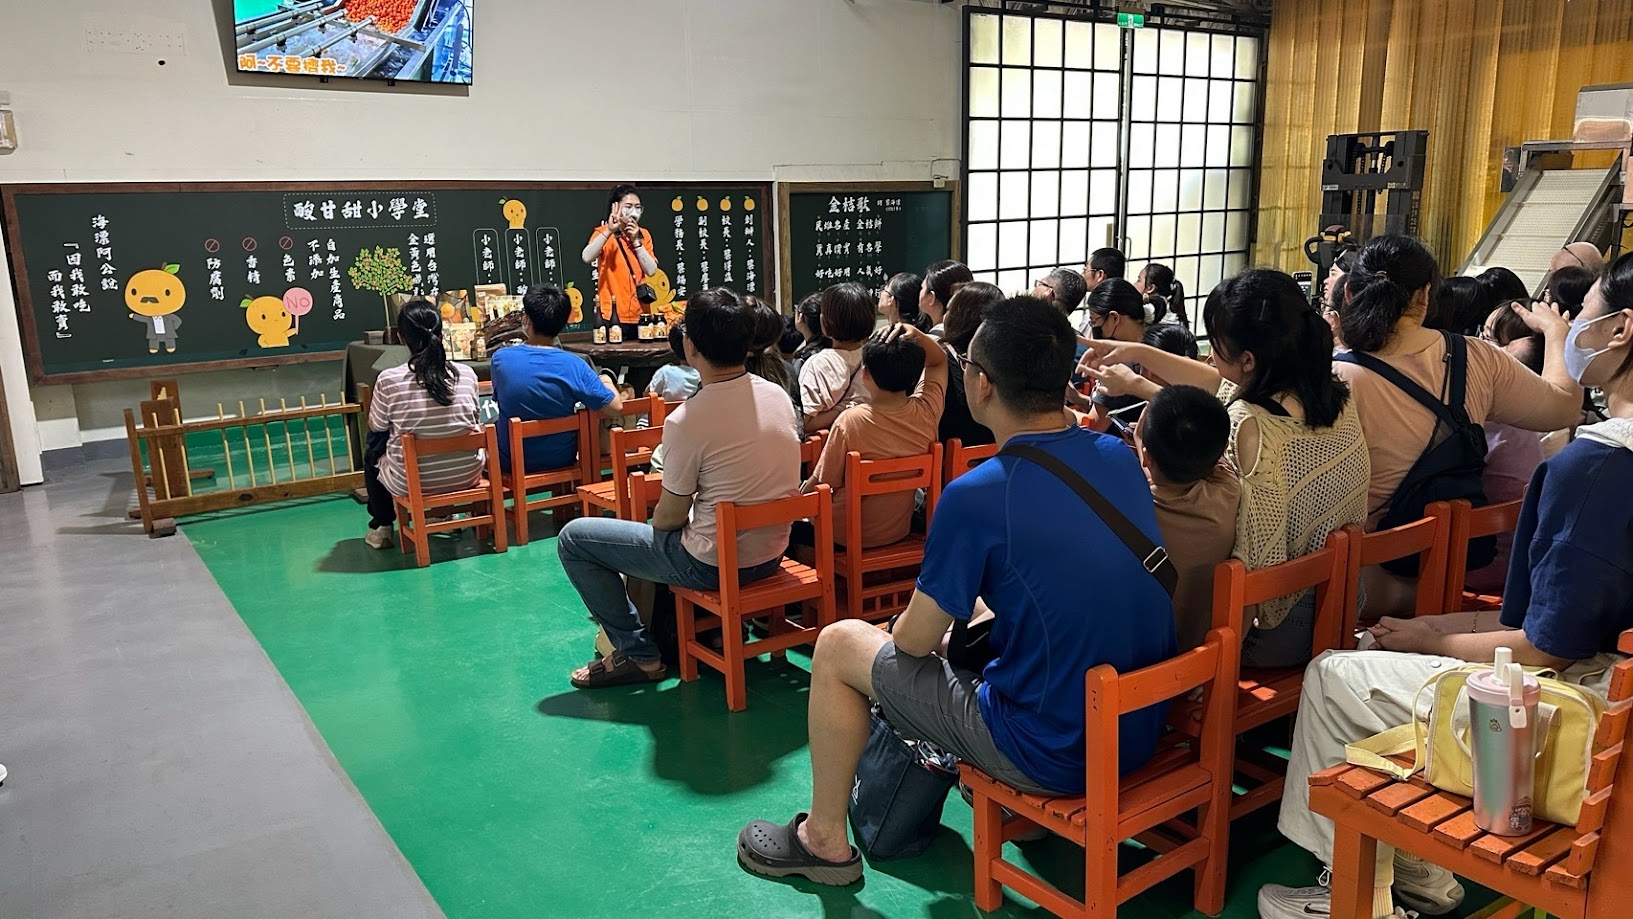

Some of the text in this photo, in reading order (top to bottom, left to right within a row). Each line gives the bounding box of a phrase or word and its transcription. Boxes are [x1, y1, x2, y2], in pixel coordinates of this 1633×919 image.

[293, 197, 430, 221] 酸甘甜小學堂
[827, 195, 871, 213] 金桔歌
[245, 254, 261, 285] 香精
[282, 253, 296, 283] 色素
[306, 239, 325, 280] 不添加
[480, 233, 495, 284] 小老師：
[542, 233, 558, 289] 小老師：
[206, 257, 225, 301] 防腐劑
[285, 296, 311, 309] NO
